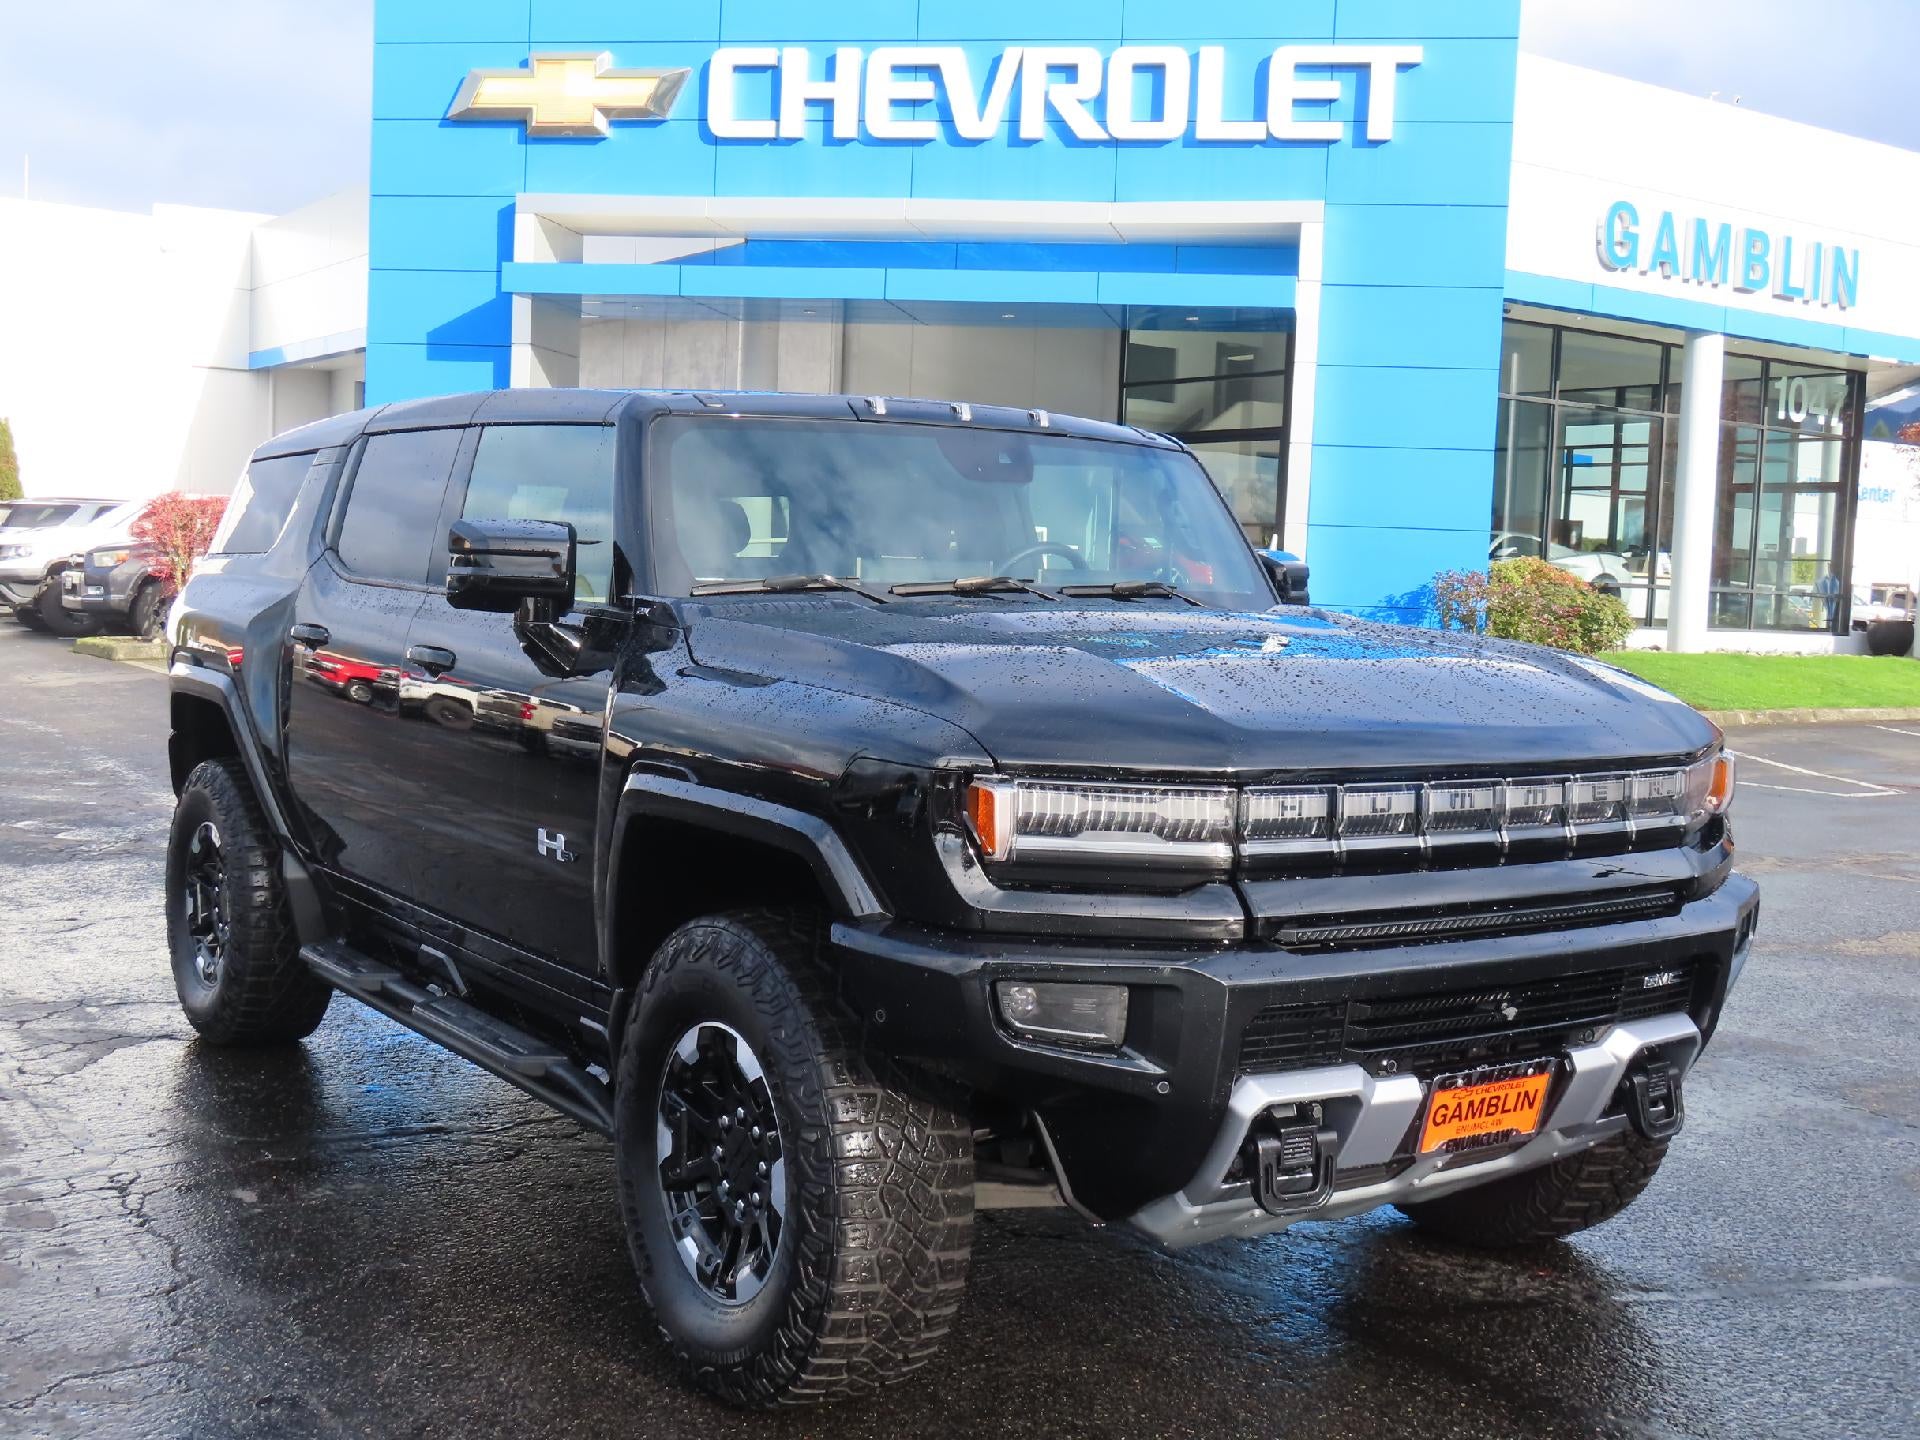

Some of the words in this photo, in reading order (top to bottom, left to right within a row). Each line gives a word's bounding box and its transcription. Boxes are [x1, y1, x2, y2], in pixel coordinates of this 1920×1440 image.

[708, 45, 1422, 141] CHEVROLET
[1598, 200, 1858, 308] GAMBLIN
[1432, 1088, 1538, 1127] GAMBLIN
[1475, 1080, 1528, 1095] CHEVROLET
